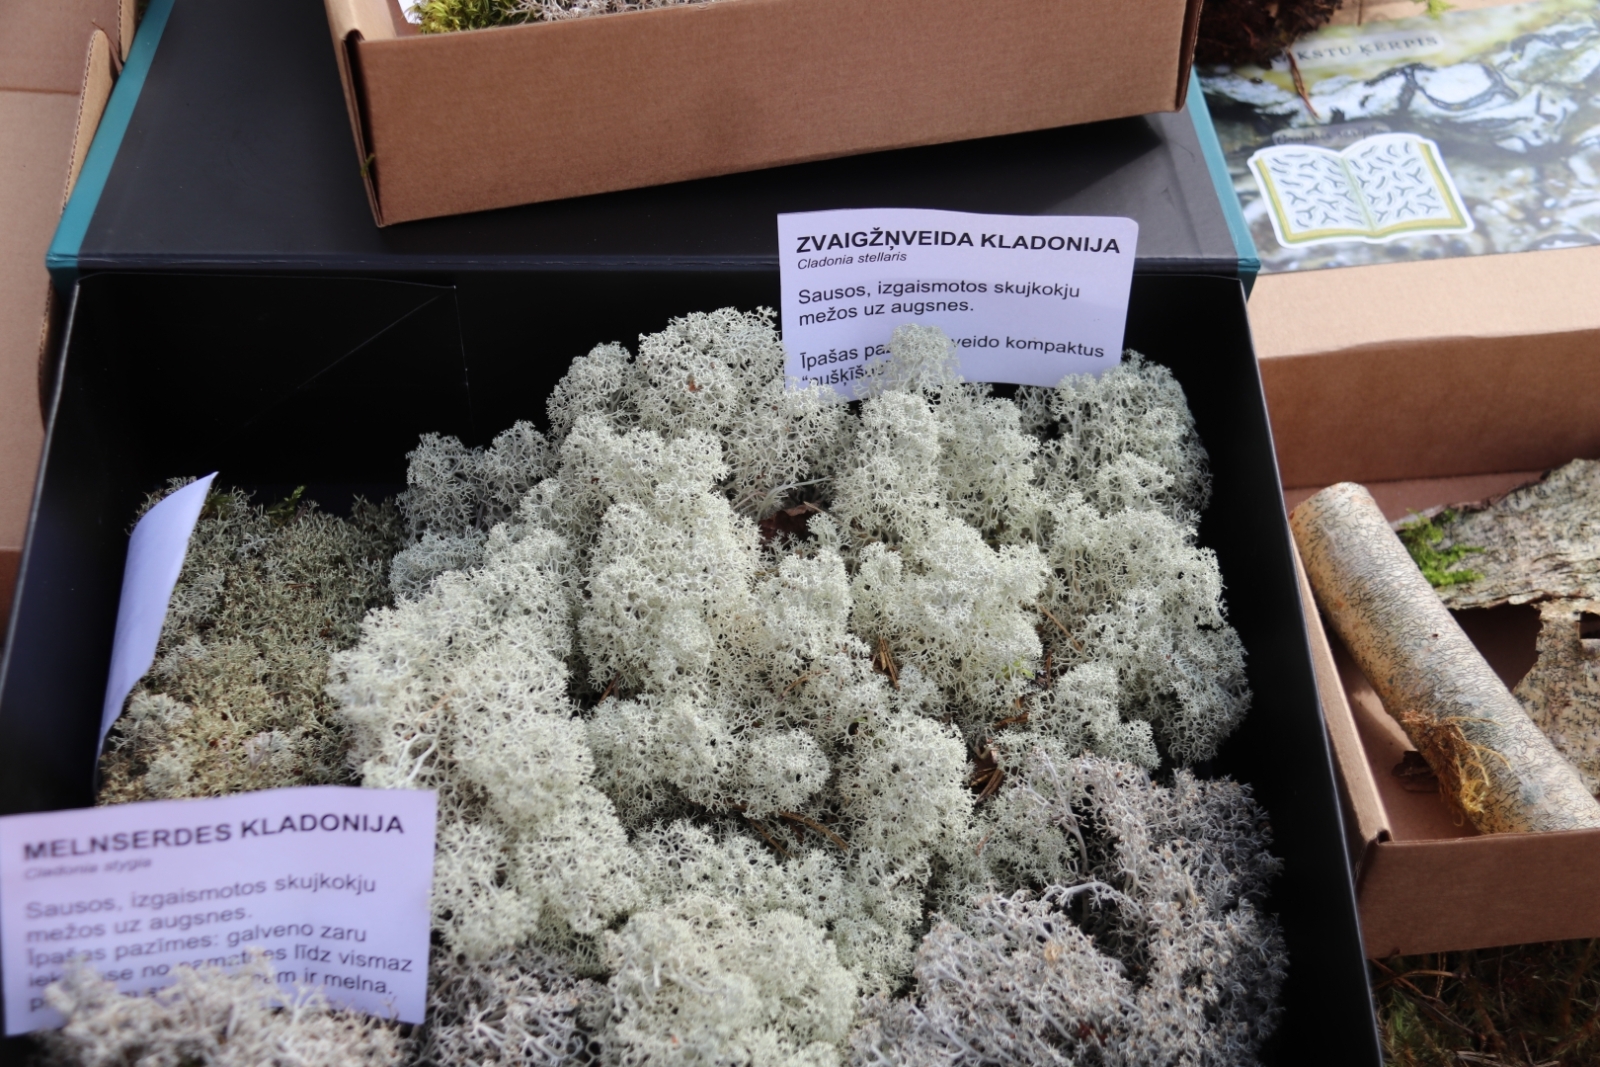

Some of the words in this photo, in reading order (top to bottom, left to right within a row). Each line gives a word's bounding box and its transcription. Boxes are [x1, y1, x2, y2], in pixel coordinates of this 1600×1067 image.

[1271, 46, 1351, 64] KSTU
[796, 228, 974, 252] ZVAIGŽŅVEIDA
[980, 233, 1120, 254] KLADONIJA
[797, 254, 854, 270] Cladonia
[857, 250, 907, 264] stellaris
[798, 284, 872, 304] Sausos,
[877, 278, 988, 296] izgaismotos
[993, 279, 1080, 299] skujkokju
[798, 305, 858, 326] mežos
[863, 305, 886, 316] uz
[890, 300, 975, 316] augsnes.
[800, 348, 858, 371] Īpašas
[1005, 336, 1105, 358] kompaktus
[23, 823, 232, 861] MELNSERDES
[240, 813, 405, 838] KLADONIJA
[26, 897, 123, 920] Sausos,
[131, 880, 267, 910] izgaismotos
[274, 872, 377, 896] skujkokju
[27, 919, 107, 944] mežos
[113, 918, 142, 936] uz
[149, 907, 253, 932] augsnes.
[115, 934, 219, 962] pazīmes:
[227, 922, 315, 949] galveno
[320, 924, 368, 943] zaru
[28, 968, 134, 989] iekse
[141, 963, 171, 977] no
[294, 943, 332, 963] līdz
[338, 949, 414, 973] vismaz
[323, 973, 395, 996] melna.
